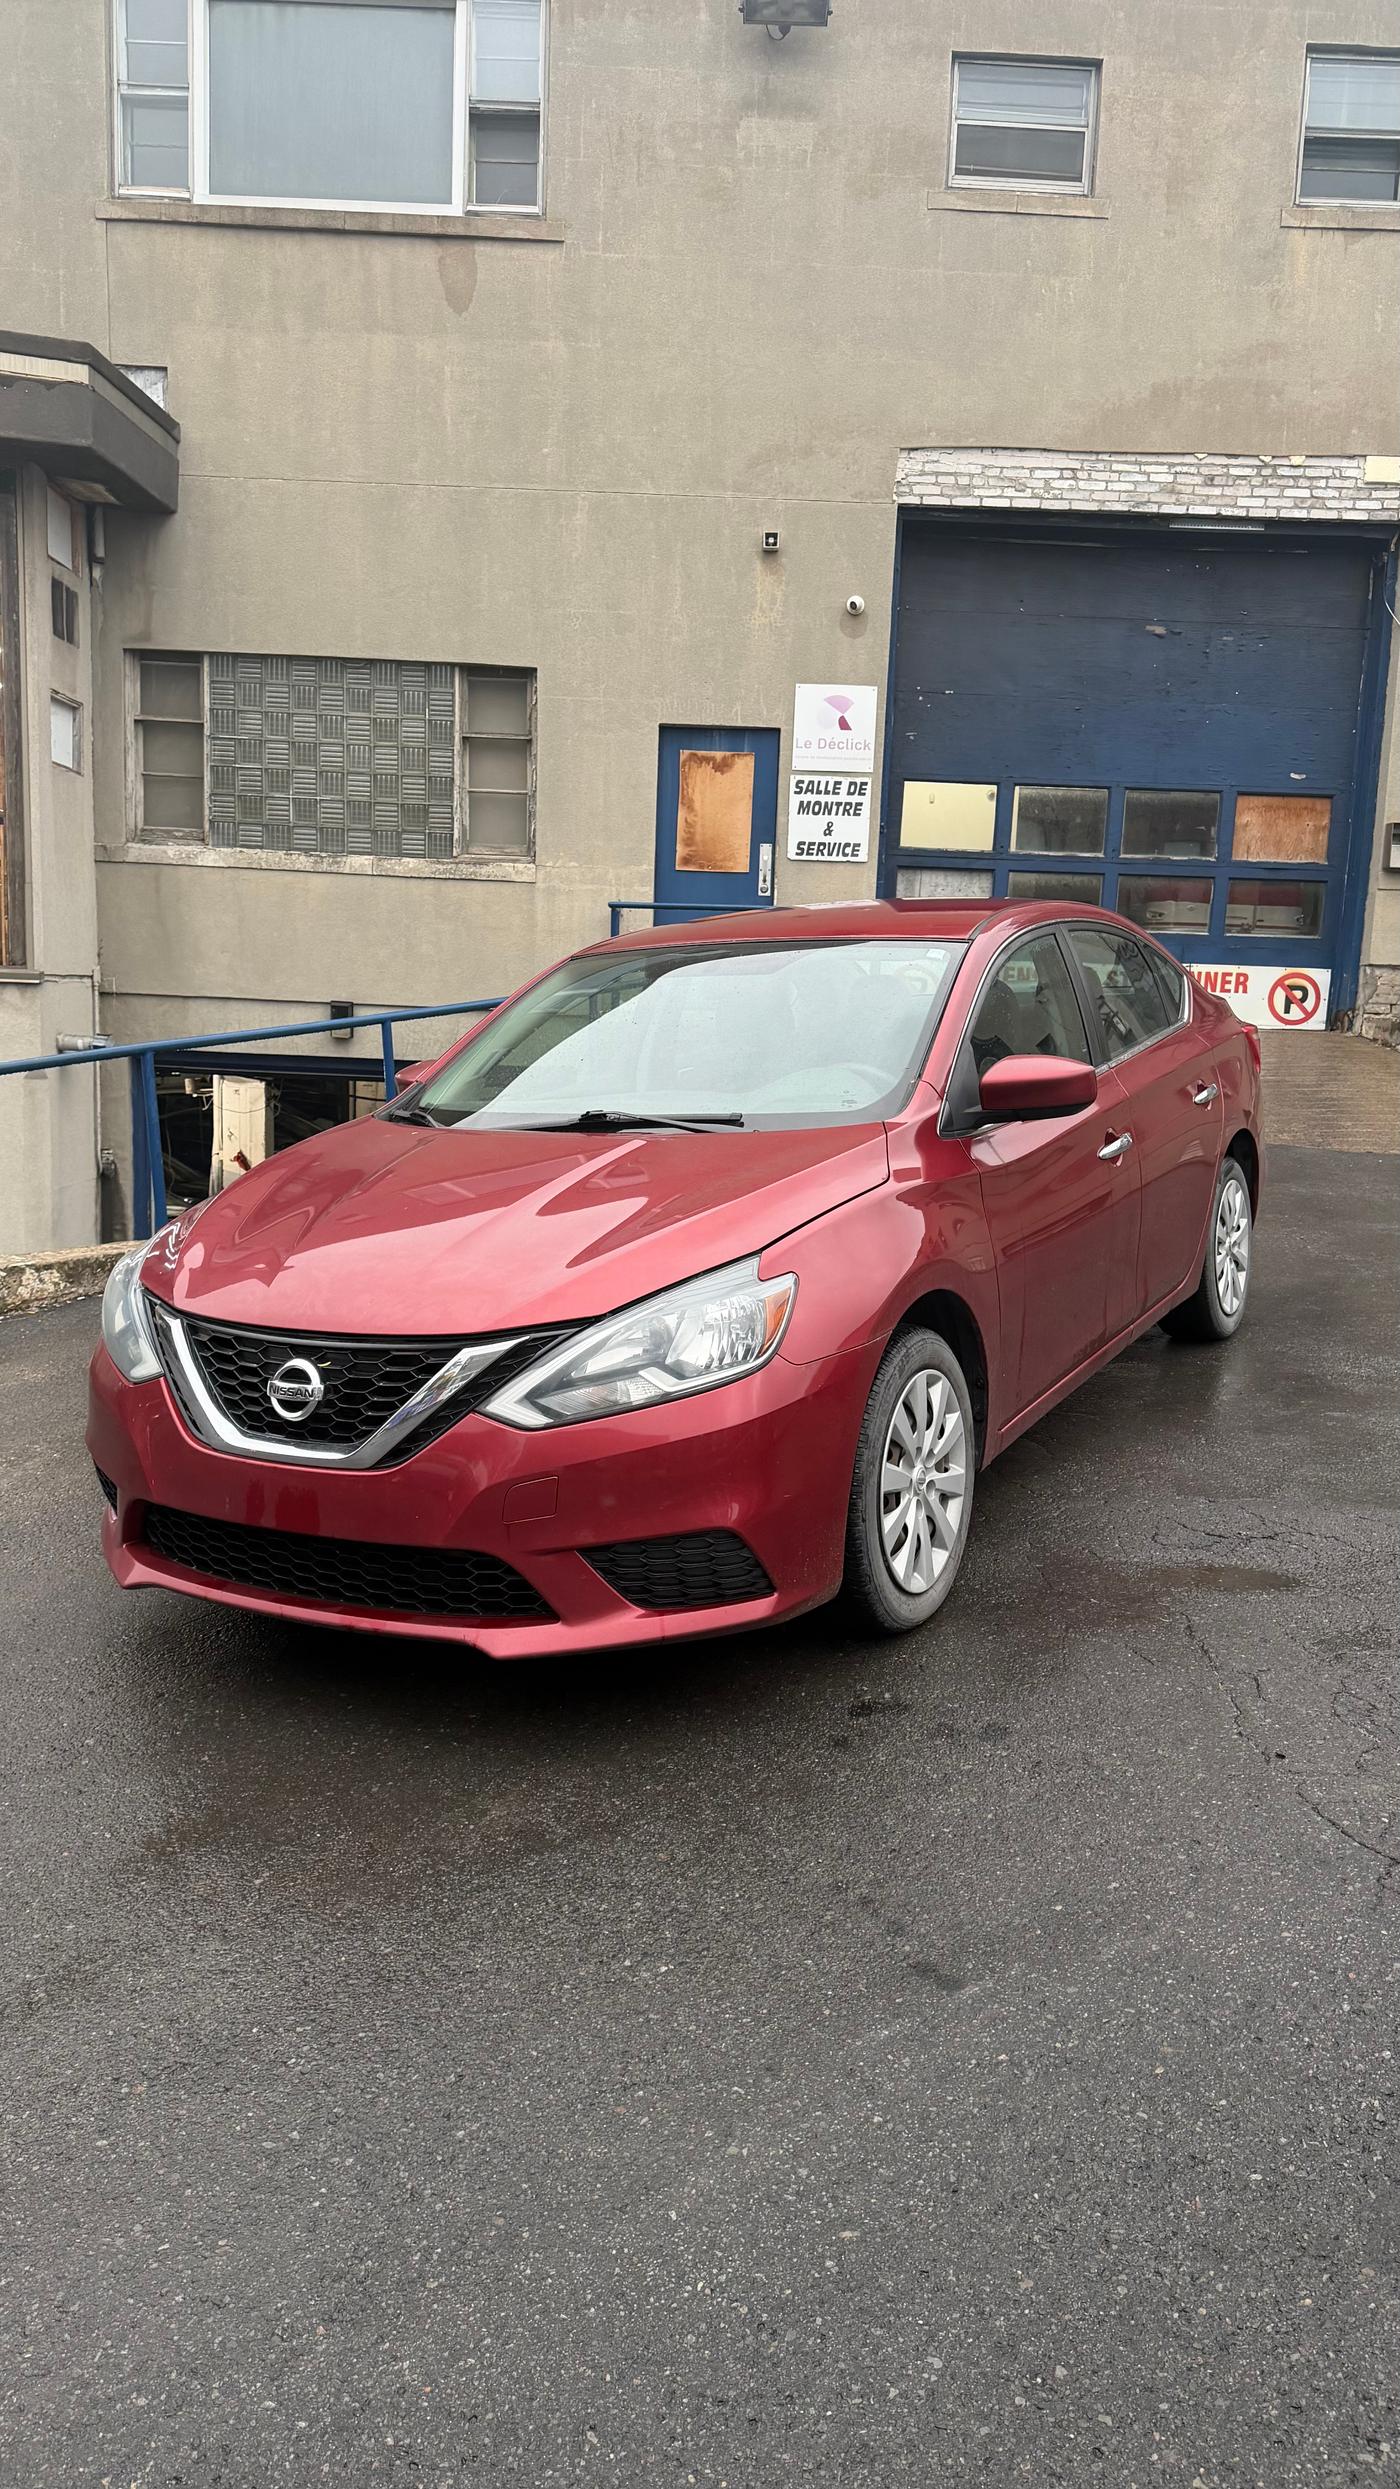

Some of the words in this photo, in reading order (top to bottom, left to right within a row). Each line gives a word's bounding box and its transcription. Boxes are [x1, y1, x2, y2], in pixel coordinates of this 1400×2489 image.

[796, 738, 812, 749] Le
[818, 737, 871, 751] Déclick
[794, 780, 842, 796] SALLE
[847, 781, 868, 796] DE
[797, 800, 863, 817] MONTRE
[823, 821, 834, 837] &
[795, 841, 861, 857] SERVICE
[269, 1385, 315, 1398] NISSAN
